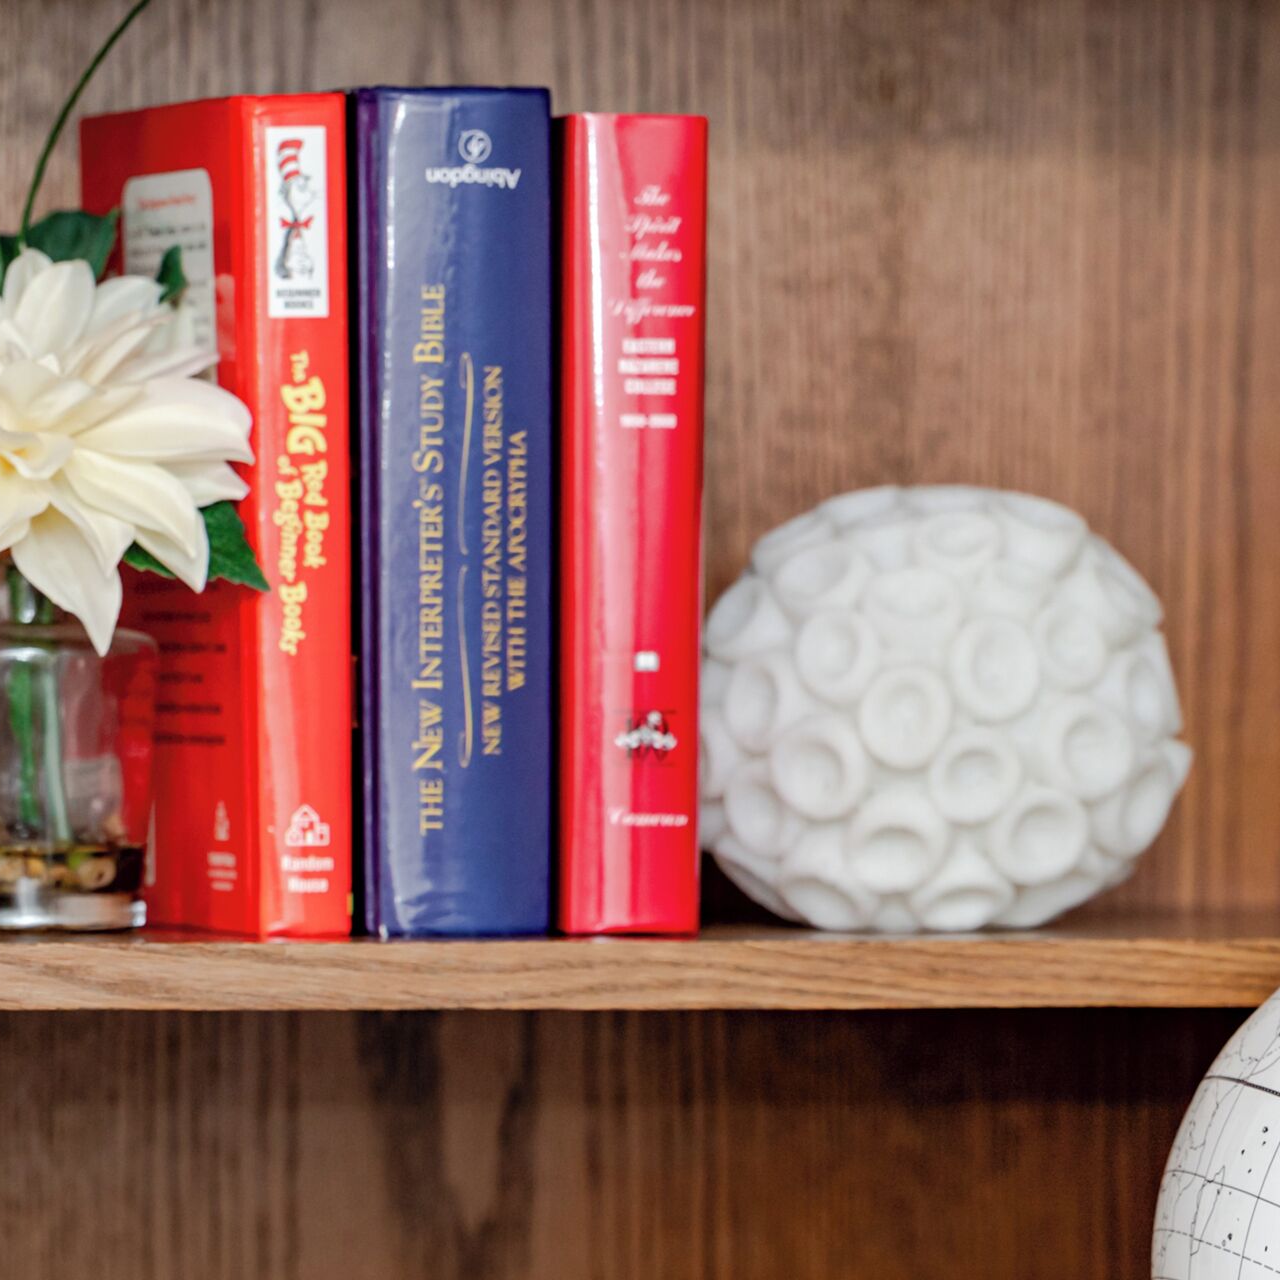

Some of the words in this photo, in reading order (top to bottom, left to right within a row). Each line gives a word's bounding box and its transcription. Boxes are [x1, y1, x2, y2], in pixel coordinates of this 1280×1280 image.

[425, 164, 521, 189] Abingdon
[412, 283, 446, 365] BIBLE
[289, 349, 309, 384] The
[280, 374, 328, 456] BIG
[410, 373, 445, 474] STUDY
[482, 365, 504, 467] VERSION
[276, 454, 299, 476] of
[506, 429, 528, 573] APOCRYPHA
[303, 510, 330, 569] Book
[481, 468, 503, 599] STANDARD
[278, 581, 308, 657] Books
[505, 575, 528, 624] THE
[481, 601, 502, 697] REVISED
[505, 626, 528, 693] WITH
[410, 699, 444, 772] NEW
[481, 700, 502, 756] NEW
[420, 778, 444, 837] THE
